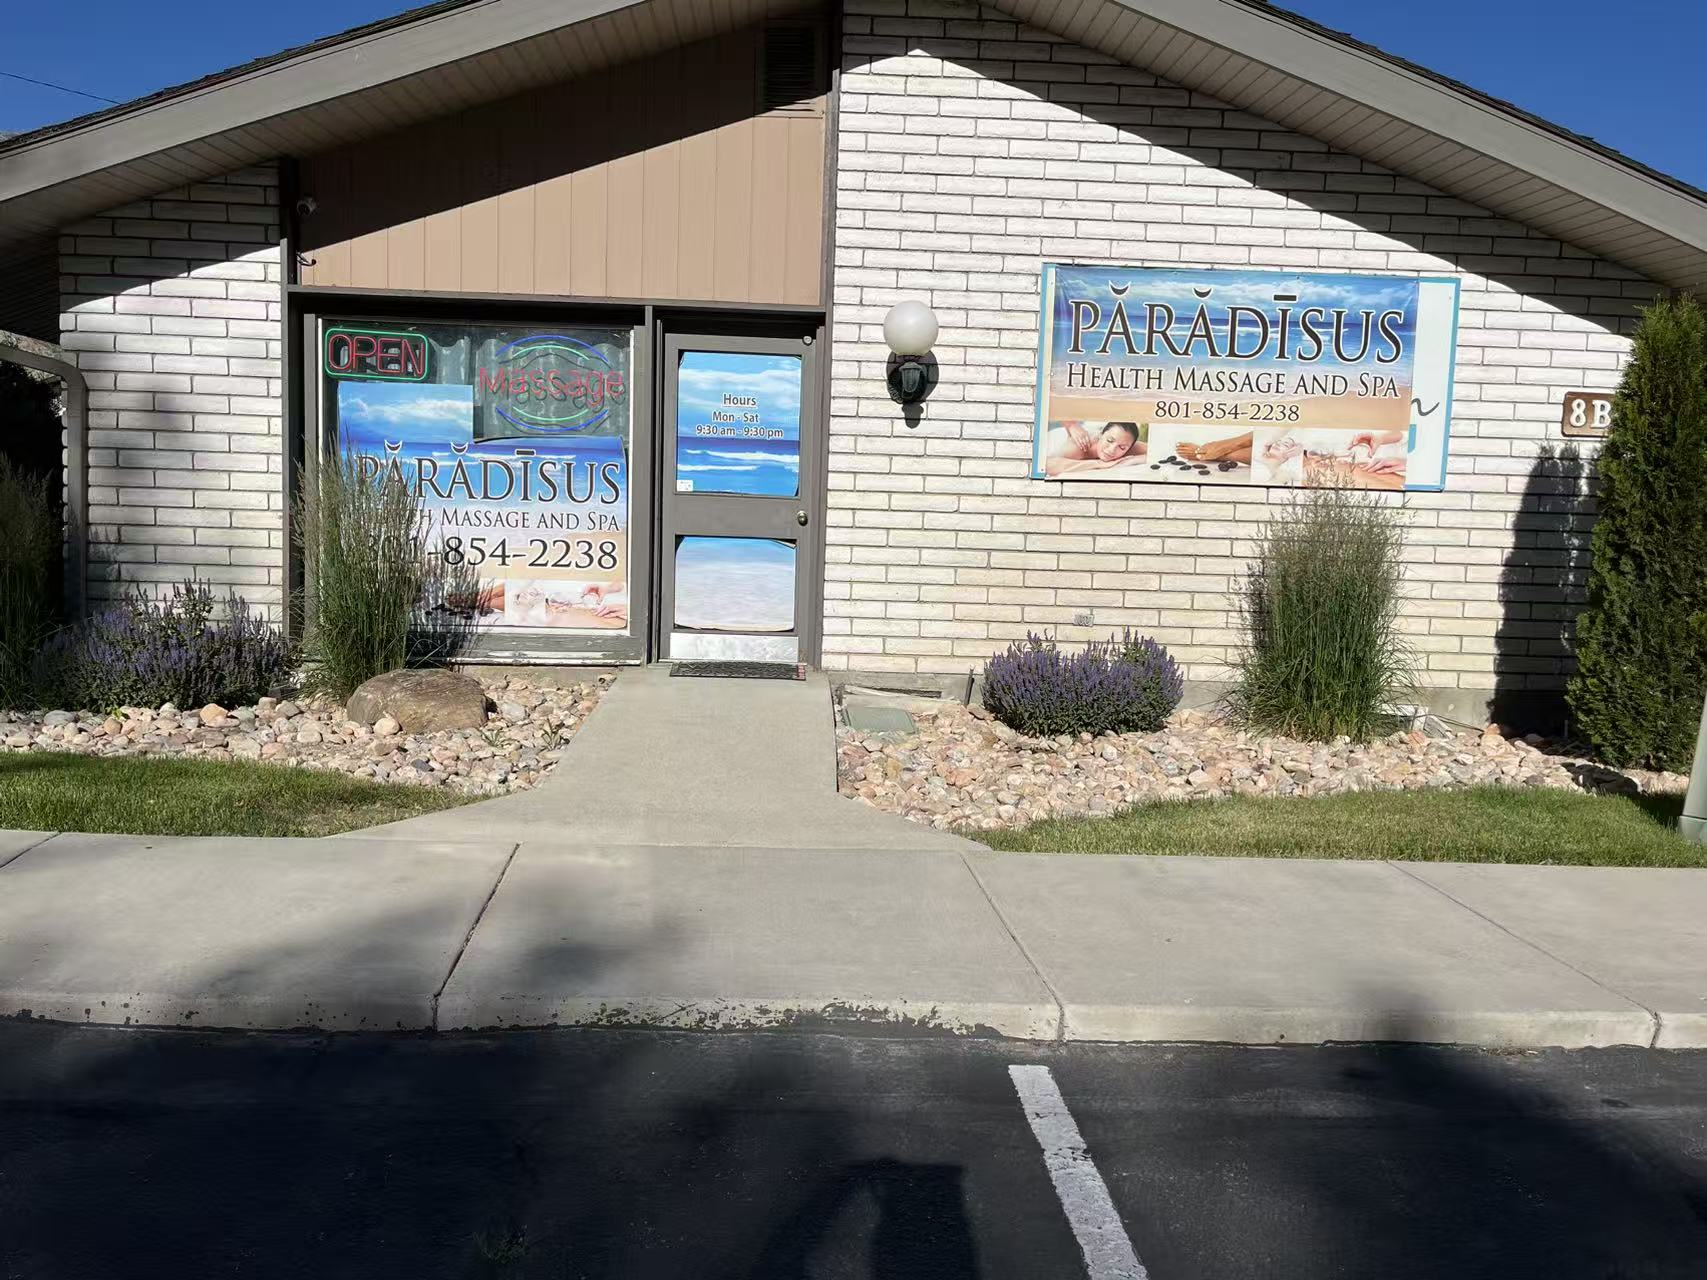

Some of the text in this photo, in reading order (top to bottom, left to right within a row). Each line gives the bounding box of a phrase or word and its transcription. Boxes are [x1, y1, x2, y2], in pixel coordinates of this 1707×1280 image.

[329, 333, 424, 376] OPEN
[479, 366, 624, 408] Massage
[723, 393, 757, 408] Hours
[1155, 400, 1300, 421] 801-854-2238
[712, 411, 735, 422] Mon
[743, 412, 759, 423] Sat
[1569, 398, 1612, 428] 8B
[696, 425, 718, 435] 9:30
[720, 426, 736, 435] am
[743, 427, 765, 437] 9:30
[767, 429, 784, 438] pm
